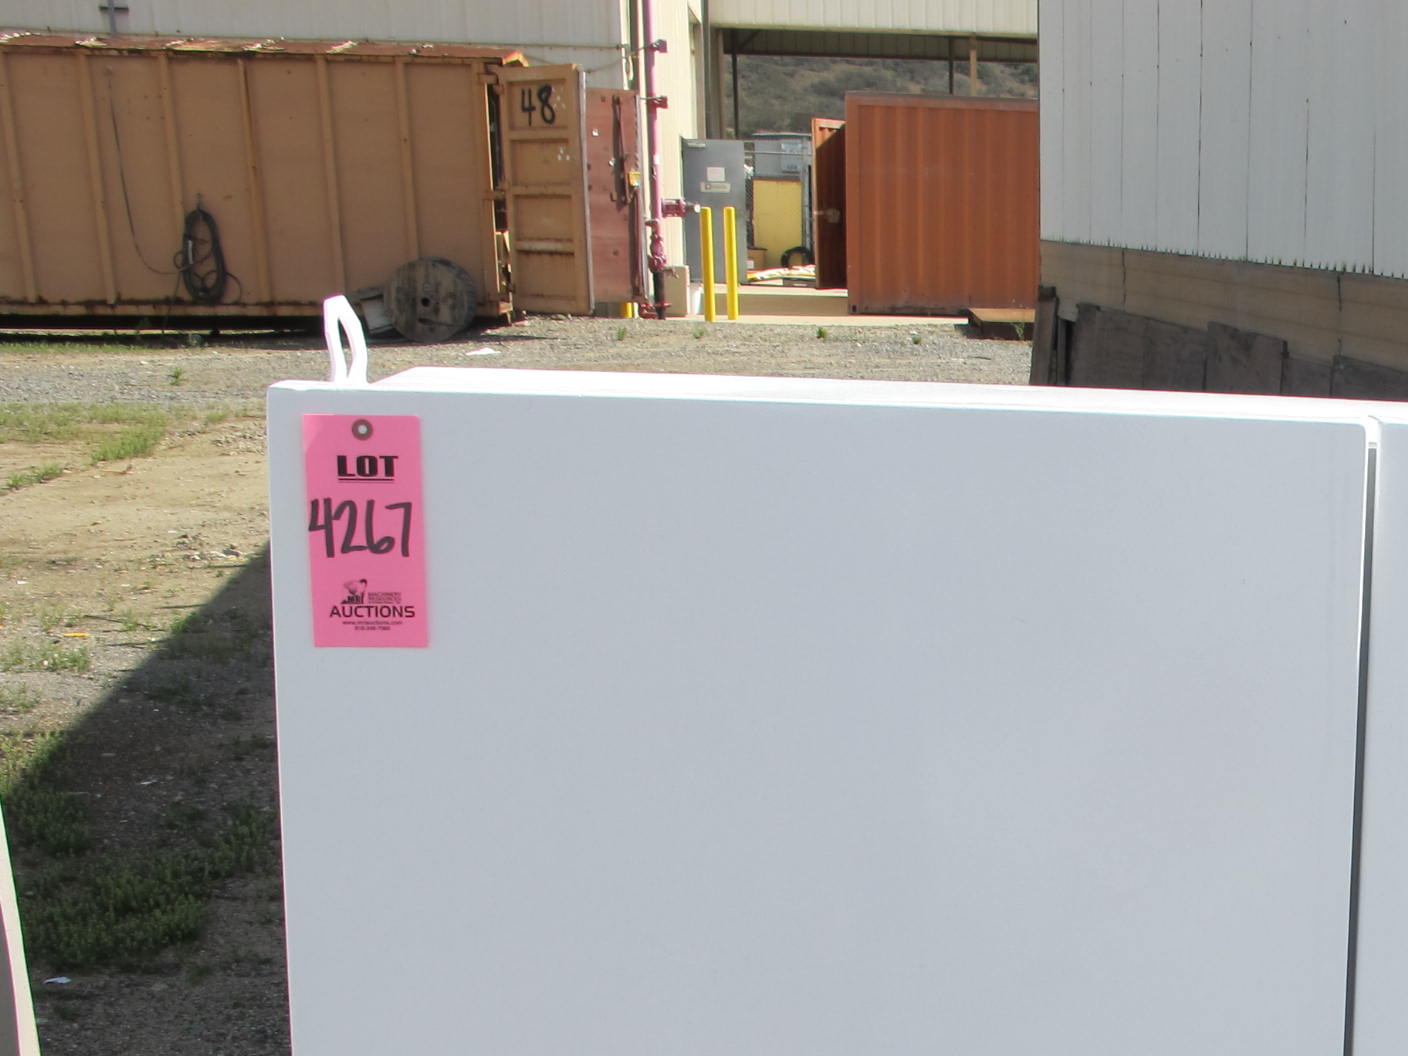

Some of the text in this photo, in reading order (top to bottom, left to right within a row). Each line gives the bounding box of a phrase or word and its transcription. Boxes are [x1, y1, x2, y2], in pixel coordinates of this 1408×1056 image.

[521, 84, 556, 126] 48
[336, 455, 399, 477] LOT
[308, 498, 413, 558] 4267
[329, 605, 416, 618] AUCTIONS
